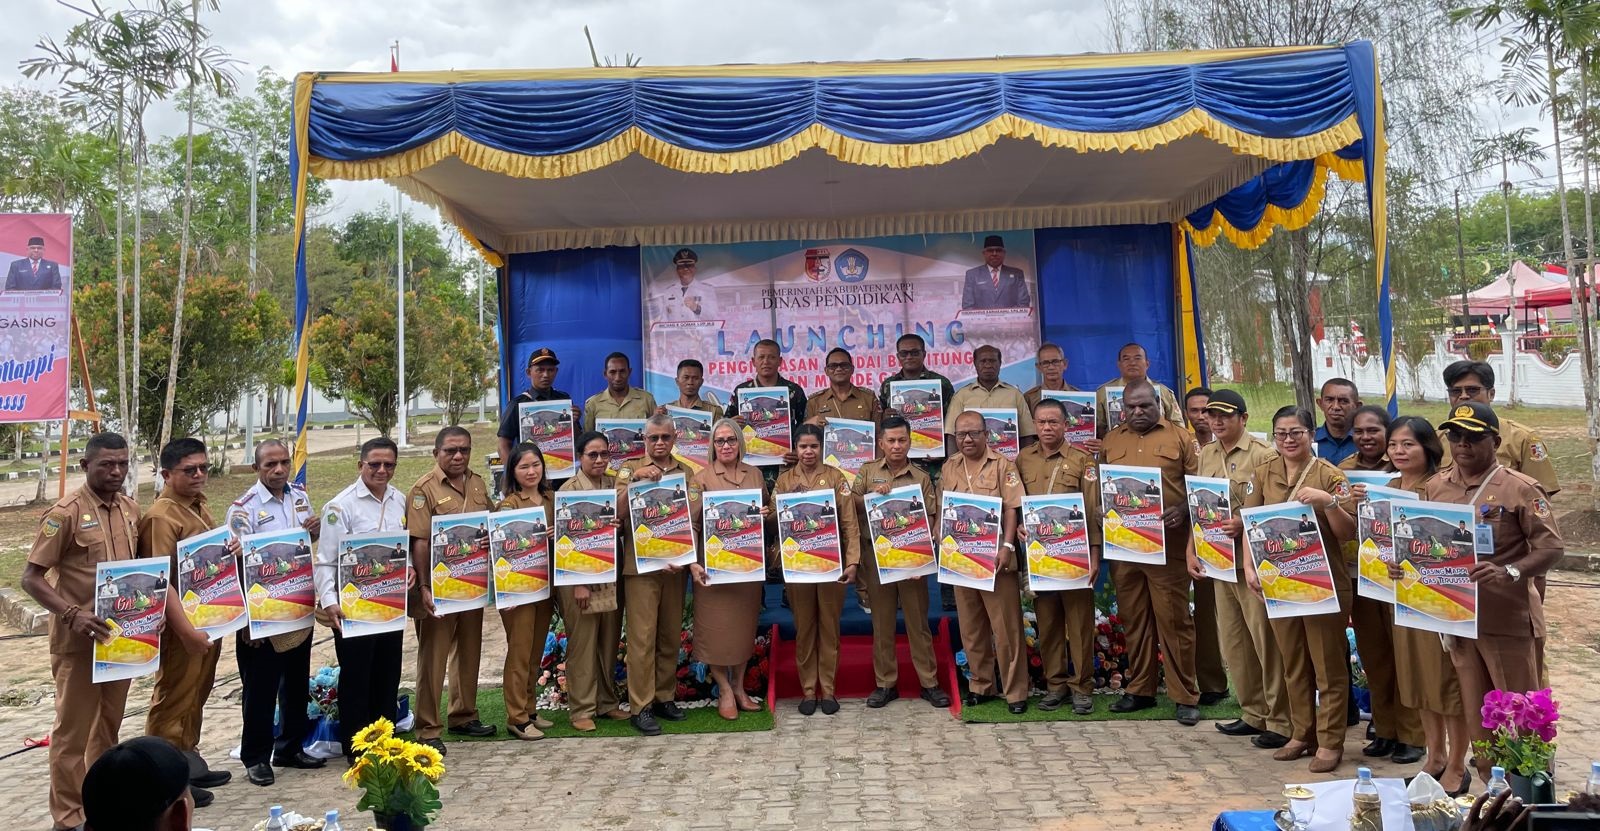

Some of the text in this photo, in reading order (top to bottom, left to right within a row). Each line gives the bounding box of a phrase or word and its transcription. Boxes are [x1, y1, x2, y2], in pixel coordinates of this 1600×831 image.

[761, 283, 914, 297] PEMERINTAH KABUPATEN MAPPI
[762, 291, 914, 309] DINAS PENDIDIKAN
[0, 317, 56, 328] GASING
[708, 358, 818, 374] PENGIASAN
